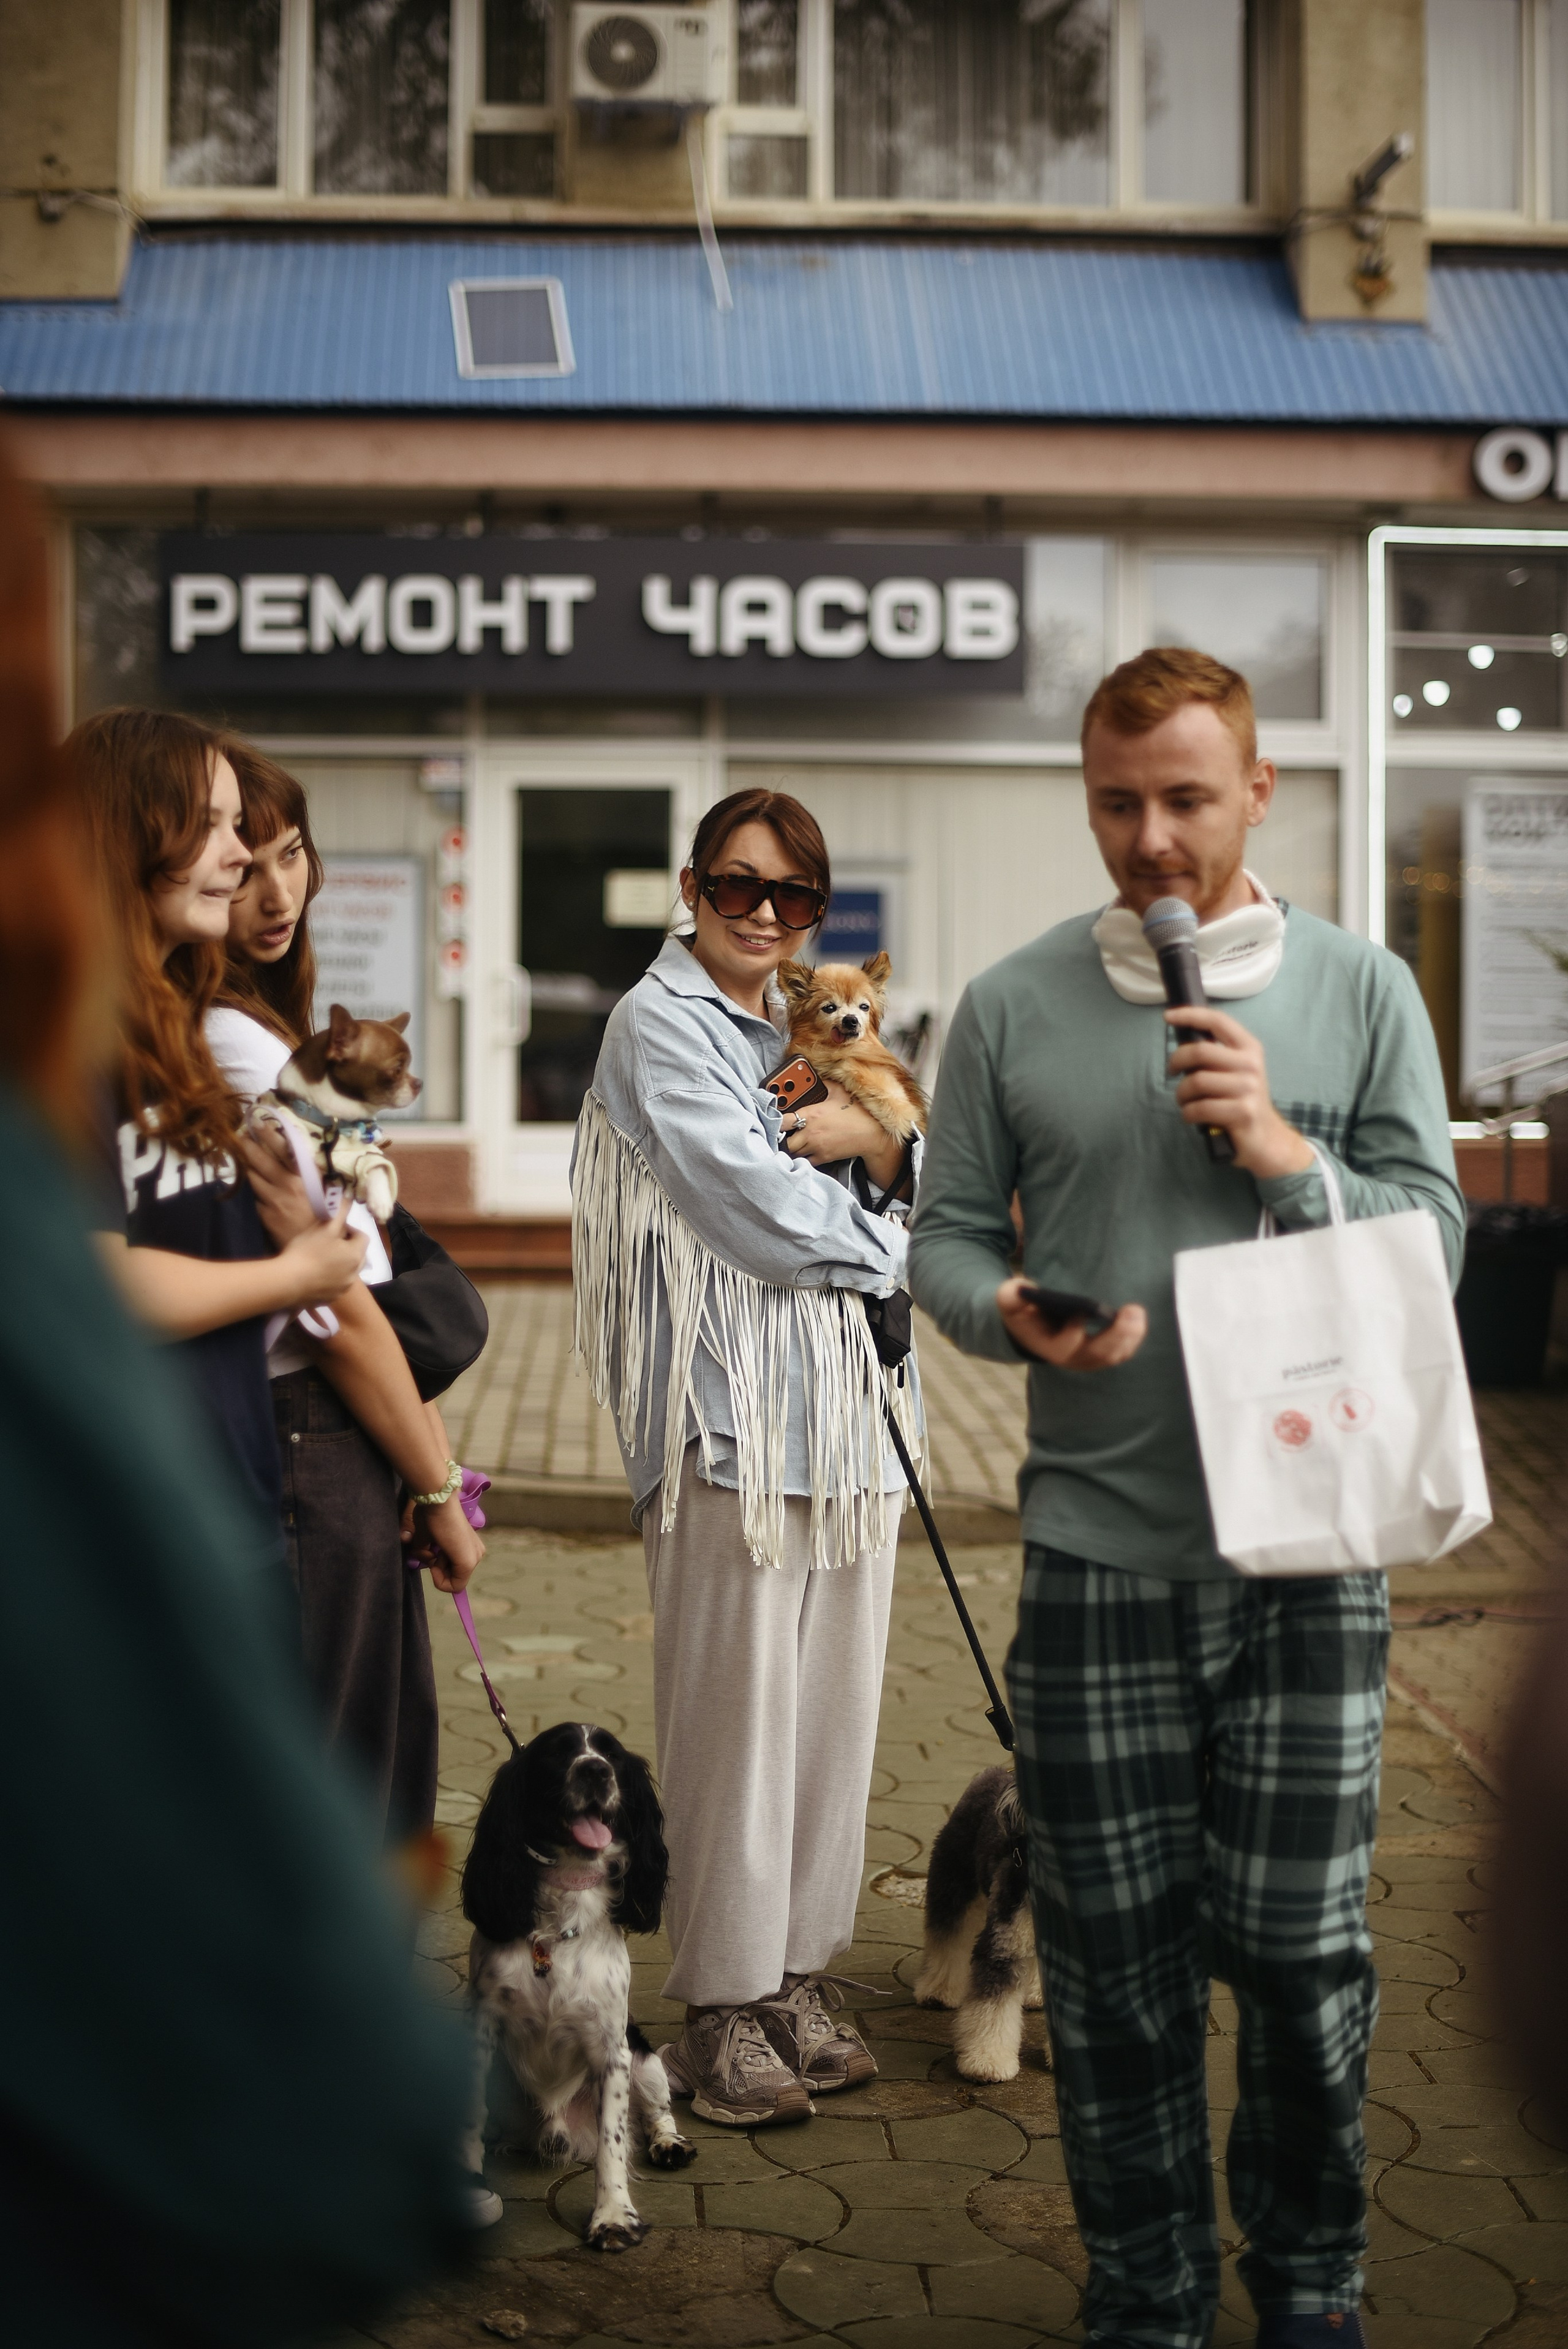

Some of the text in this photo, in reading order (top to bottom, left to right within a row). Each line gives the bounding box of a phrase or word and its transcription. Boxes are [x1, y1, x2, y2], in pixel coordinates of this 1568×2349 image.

[1472, 427, 1568, 503] О
[170, 573, 1019, 659] РЕМОНТ ЧАСОВ
